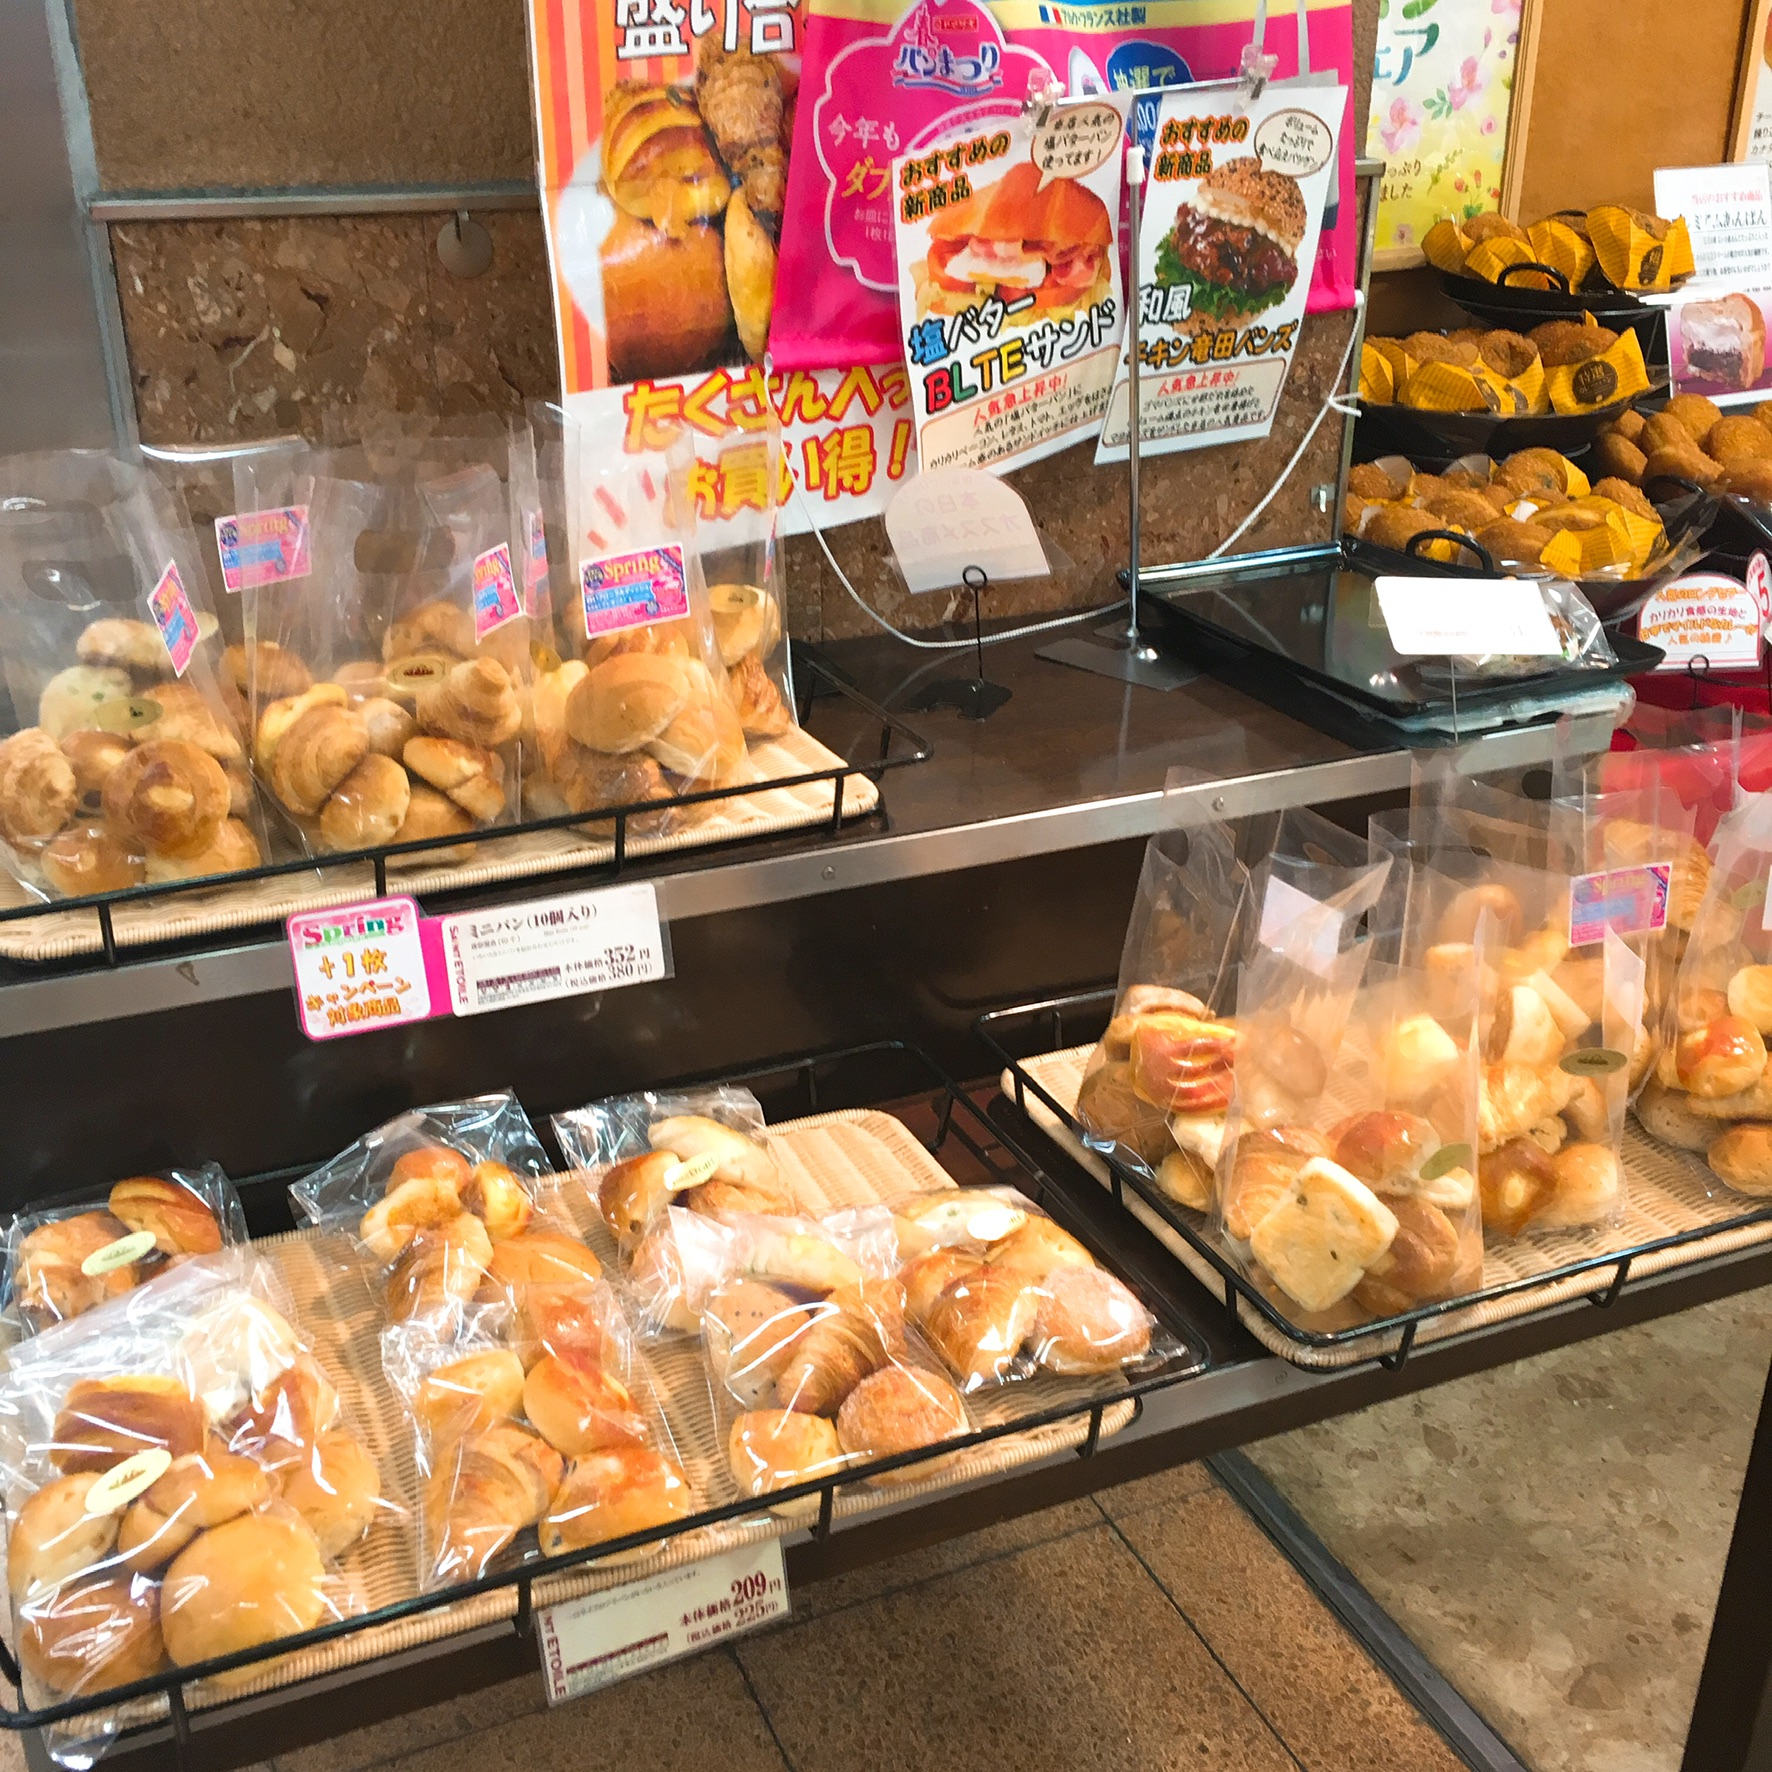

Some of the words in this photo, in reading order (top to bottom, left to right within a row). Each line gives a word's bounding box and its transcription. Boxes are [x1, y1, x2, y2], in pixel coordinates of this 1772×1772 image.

[828, 113, 900, 151] 今年も
[1158, 113, 1251, 149] おすすめの
[899, 129, 1012, 190] おすすめの
[1153, 147, 1213, 183] 新商品
[901, 172, 973, 224] 新商品
[907, 292, 1036, 366] 塩バター
[924, 299, 1117, 414] BLTEサンド
[603, 555, 661, 583] Spring
[303, 915, 405, 947] Spring
[305, 976, 412, 1012] キャンペーン
[326, 996, 402, 1028] 対象商品
